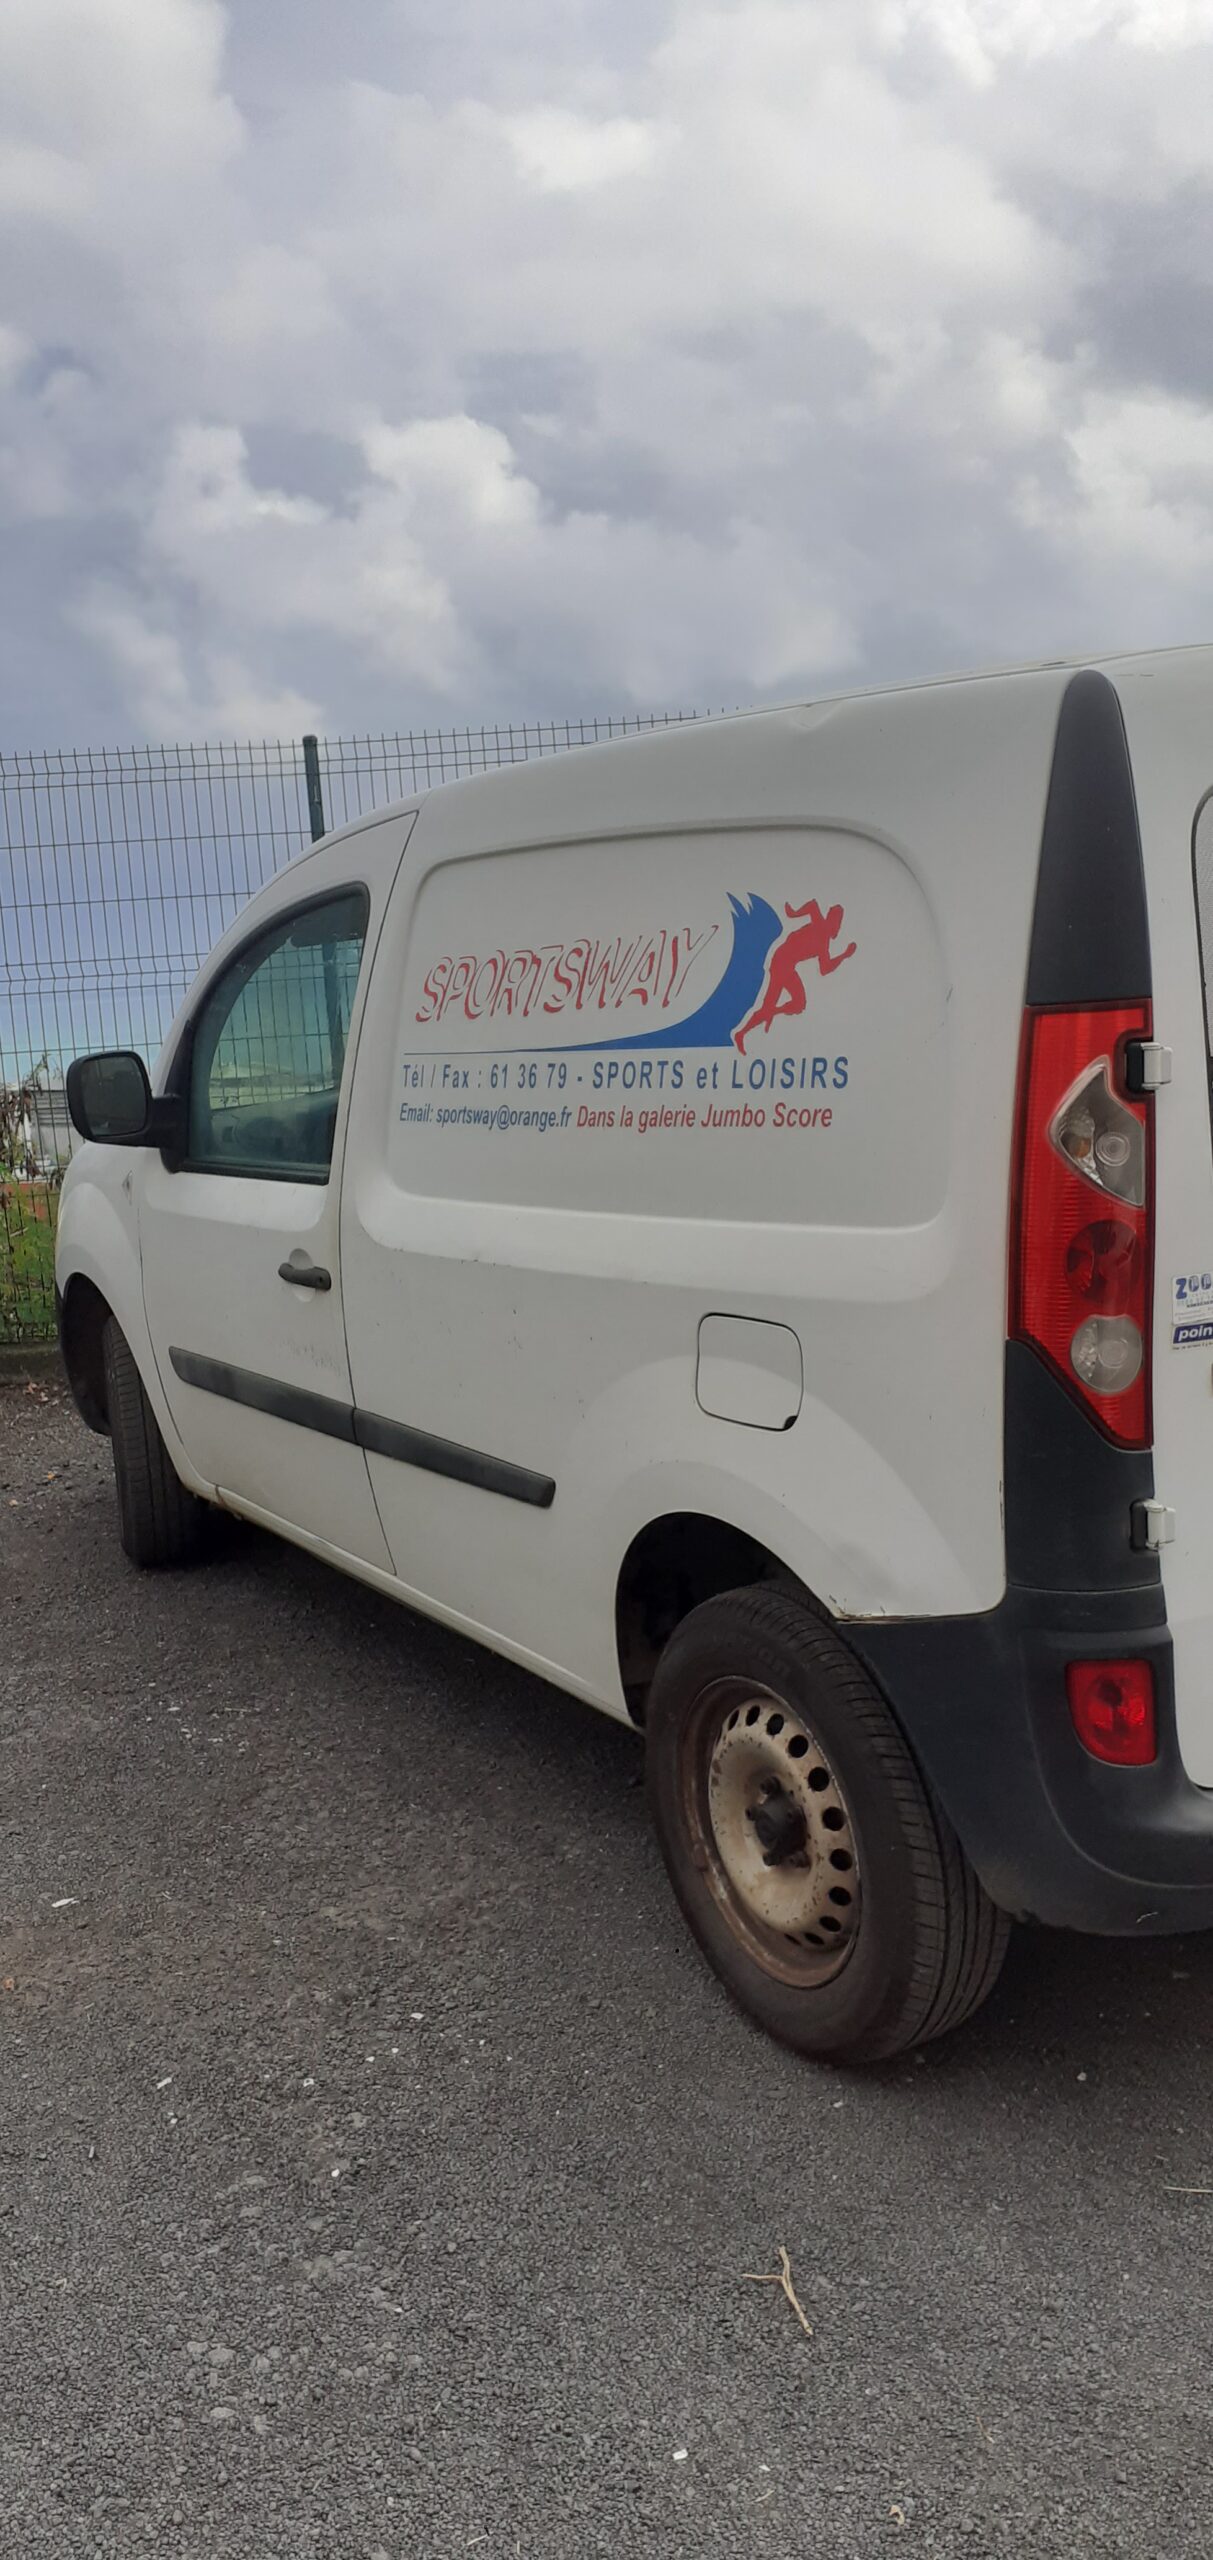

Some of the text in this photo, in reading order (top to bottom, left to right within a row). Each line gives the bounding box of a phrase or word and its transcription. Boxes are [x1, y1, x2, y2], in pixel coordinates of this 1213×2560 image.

[415, 925, 719, 1022] SPORTSWAY
[403, 1063, 424, 1088] Tél
[430, 1064, 436, 1087] /
[442, 1064, 469, 1088] Fax
[490, 1063, 508, 1089] 61
[517, 1063, 537, 1089] 36
[547, 1062, 567, 1089] 79
[592, 1060, 684, 1089] SPORTS
[696, 1062, 719, 1089] et
[731, 1056, 849, 1090] LOISIRS
[400, 1102, 833, 1134] Email: sportsway@orange.fr Dans la galerie Jumbo Score
